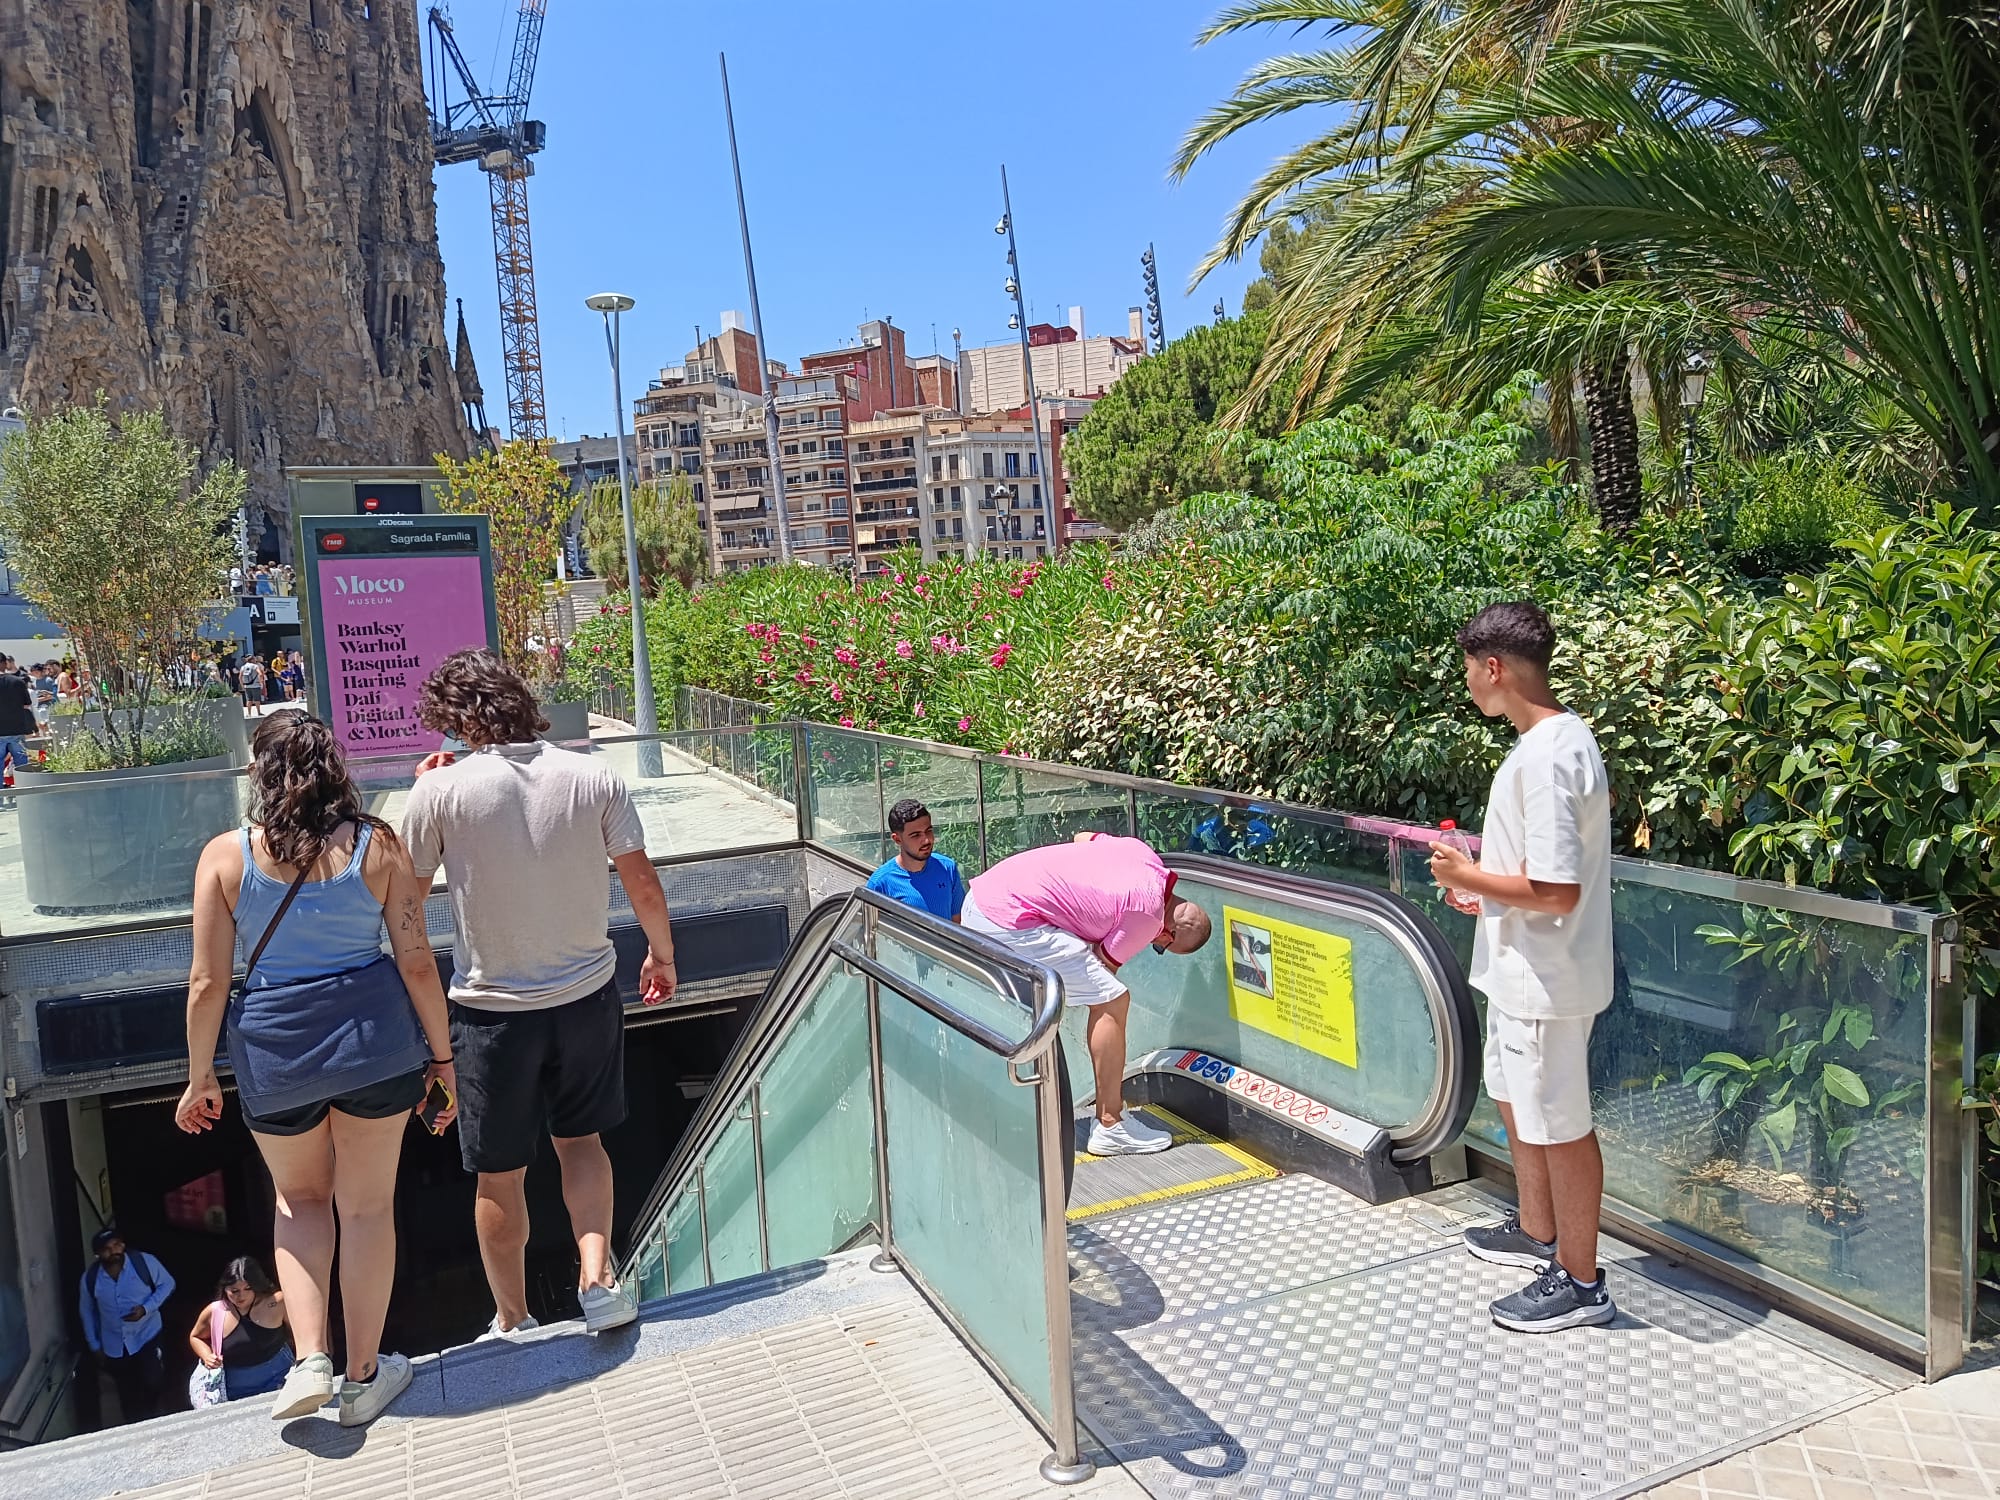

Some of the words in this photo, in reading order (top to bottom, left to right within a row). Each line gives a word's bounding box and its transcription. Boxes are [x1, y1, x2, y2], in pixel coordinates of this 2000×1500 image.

[390, 533, 433, 544] Sagrada
[436, 532, 471, 542] Família
[334, 575, 405, 596] Moco
[348, 597, 393, 606] MUSEUM
[250, 604, 260, 618] A
[337, 621, 405, 638] Banksy
[339, 637, 407, 654] Warhol
[341, 654, 421, 672] Basquiat
[343, 672, 407, 690] Haring
[344, 690, 380, 707] Dalí
[346, 708, 406, 725] Digital
[348, 727, 365, 741] &
[366, 722, 418, 740] More!
[1293, 945, 1305, 954] fotos
[1296, 979, 1307, 988] fotos
